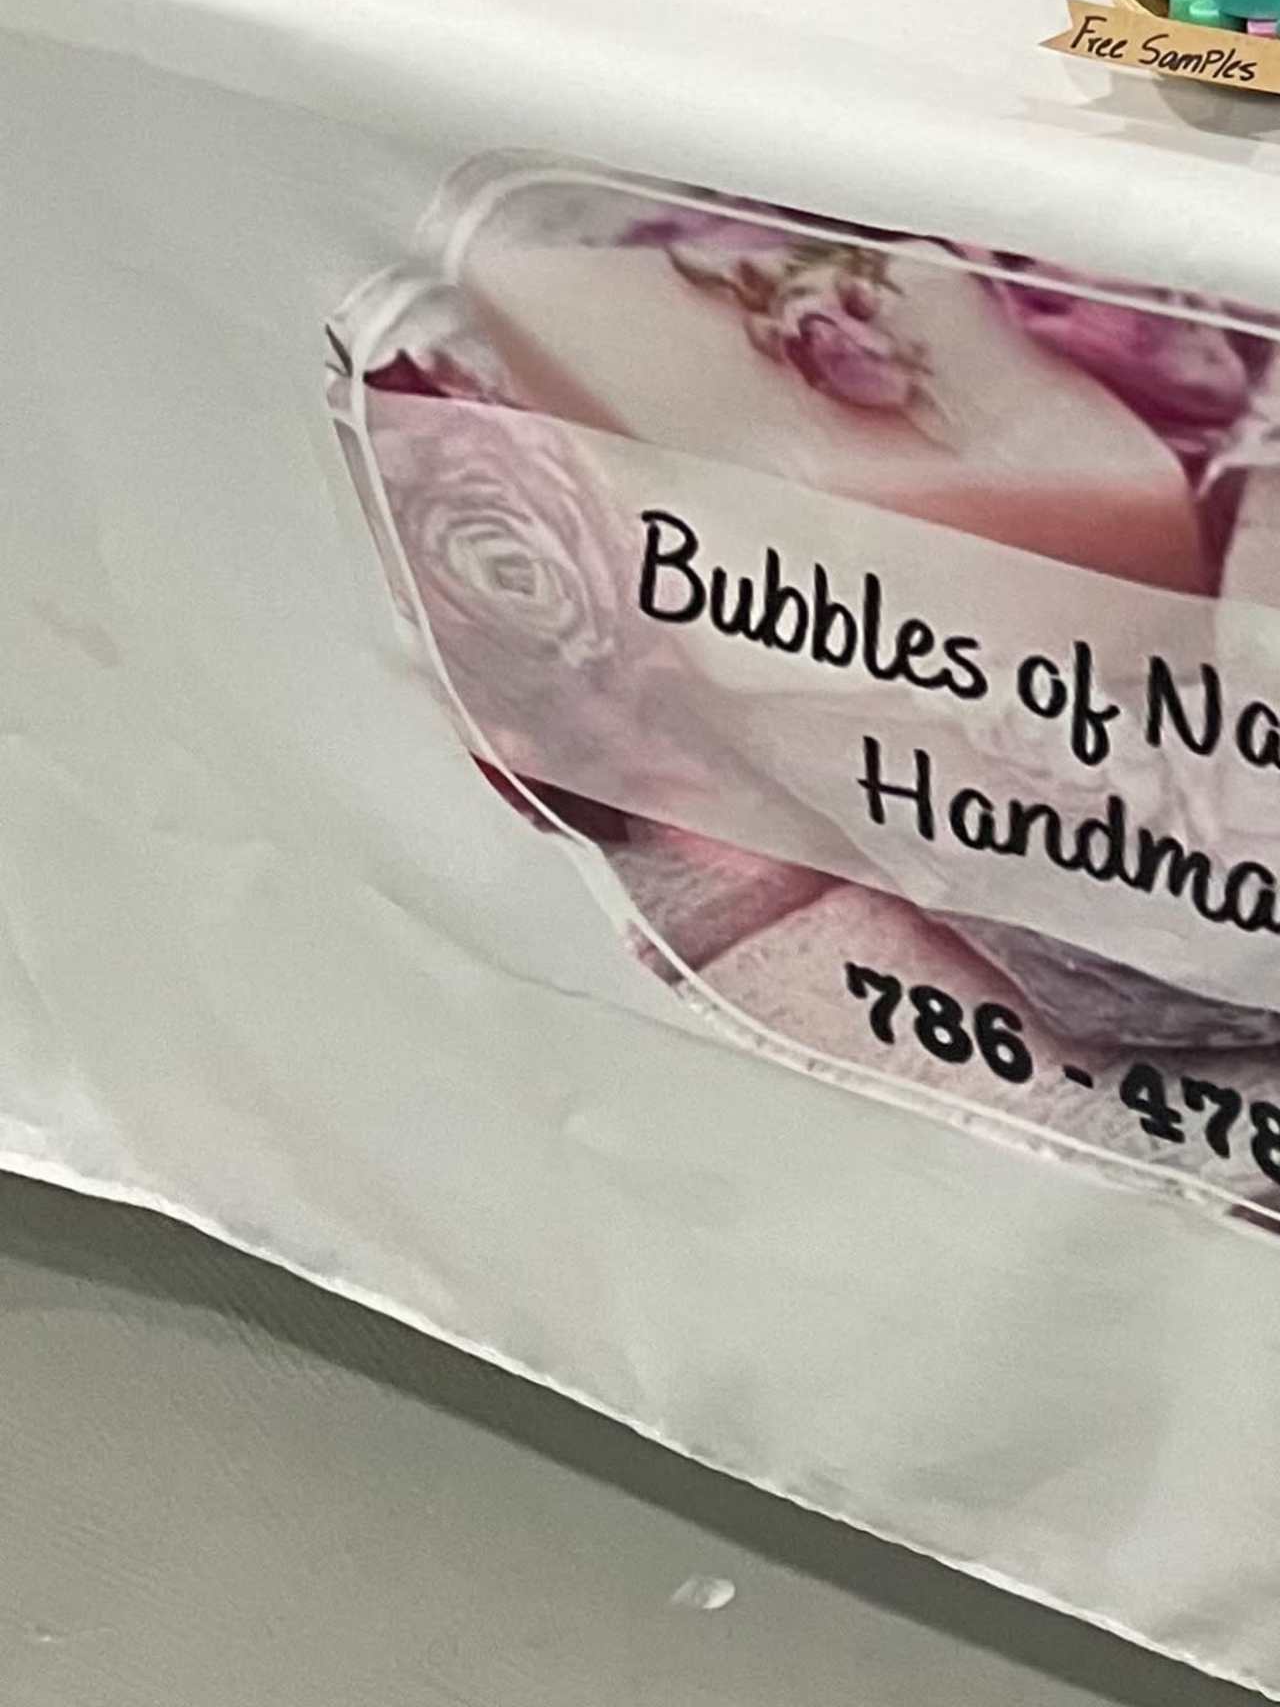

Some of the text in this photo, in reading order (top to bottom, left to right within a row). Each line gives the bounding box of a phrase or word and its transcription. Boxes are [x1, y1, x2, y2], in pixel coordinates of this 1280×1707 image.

[1070, 15, 1128, 59] Free
[639, 510, 988, 699] Bubbles
[1018, 640, 1119, 766] of
[844, 962, 1034, 1084] 786
